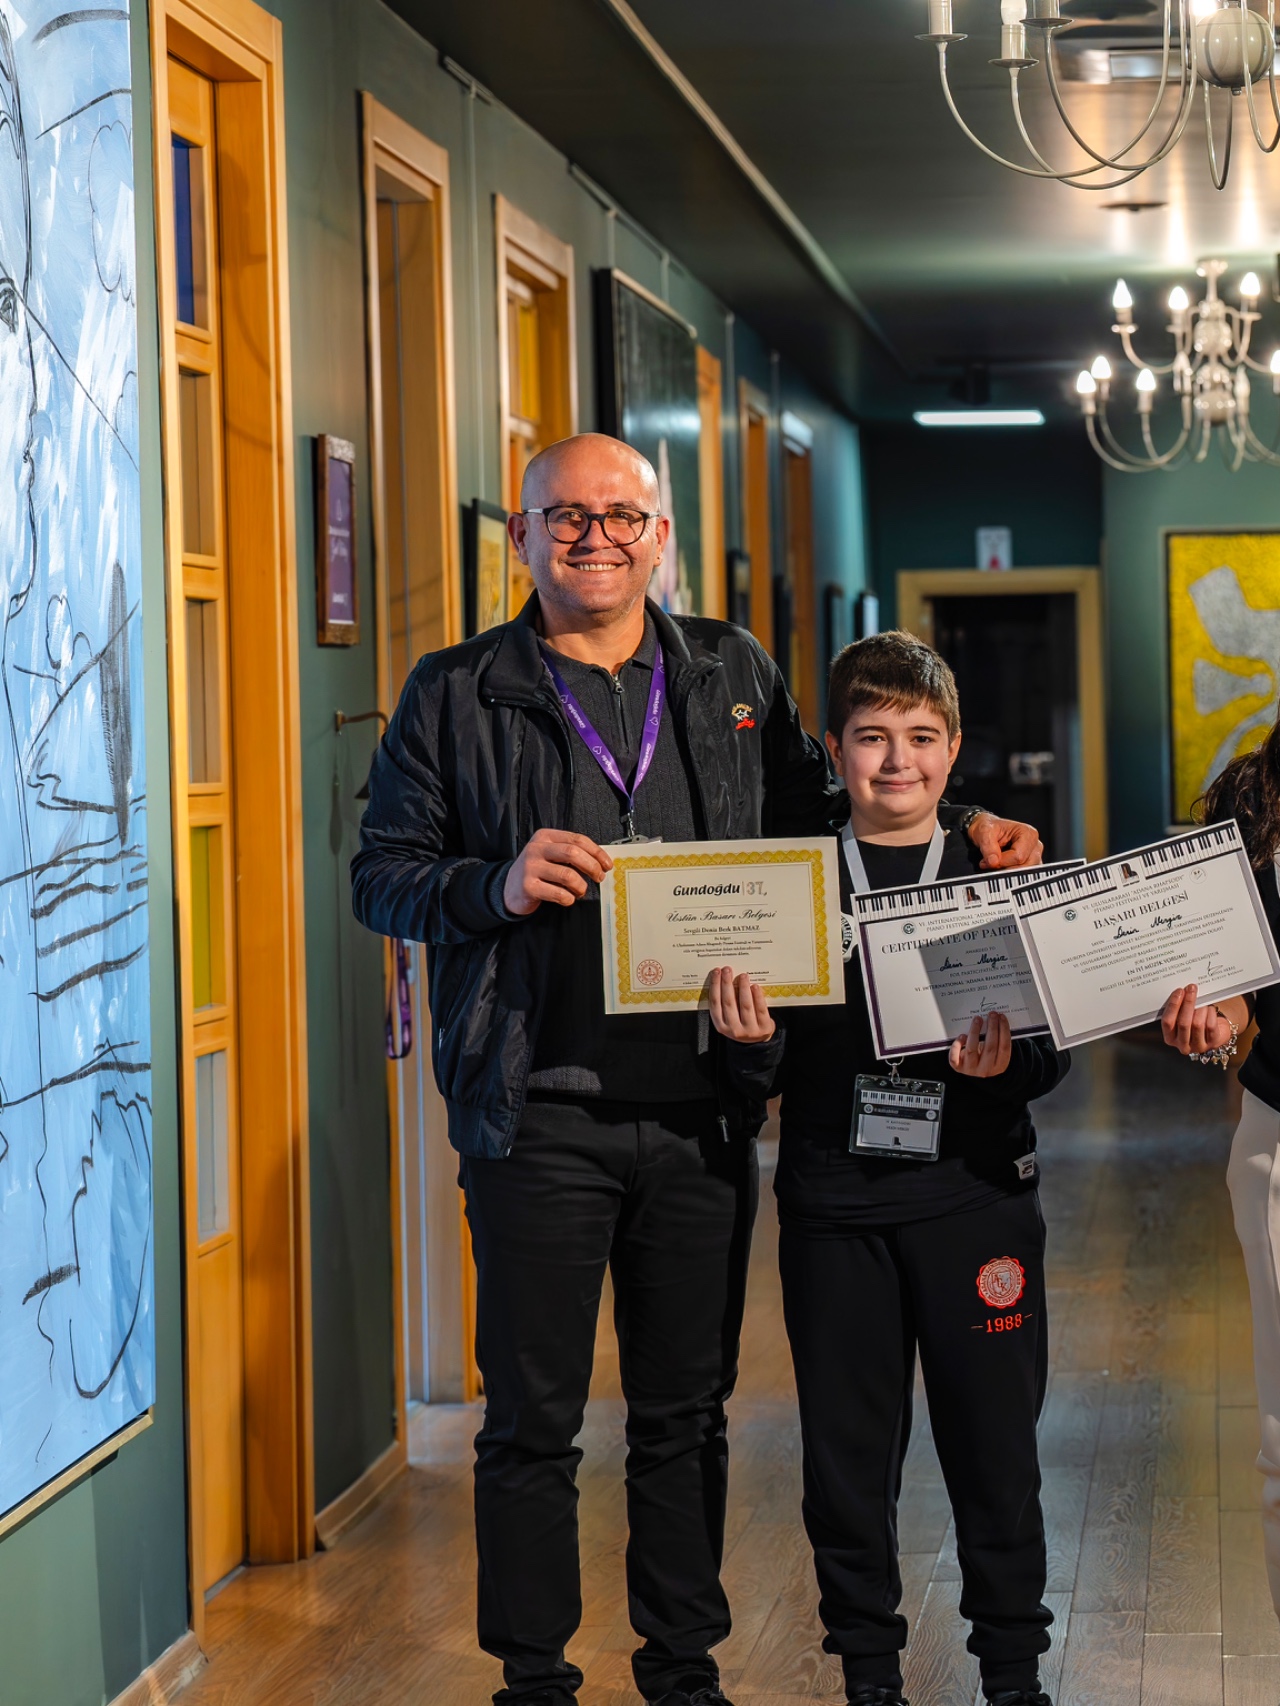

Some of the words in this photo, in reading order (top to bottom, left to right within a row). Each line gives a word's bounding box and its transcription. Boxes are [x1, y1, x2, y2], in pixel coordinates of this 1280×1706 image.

[673, 883, 740, 898] Gundoğdu
[667, 910, 697, 922] Üstün
[739, 909, 776, 921] Belgesi
[1093, 909, 1137, 930] BAŞARI
[881, 934, 961, 954] CERTIFICATE
[963, 930, 980, 942] OF
